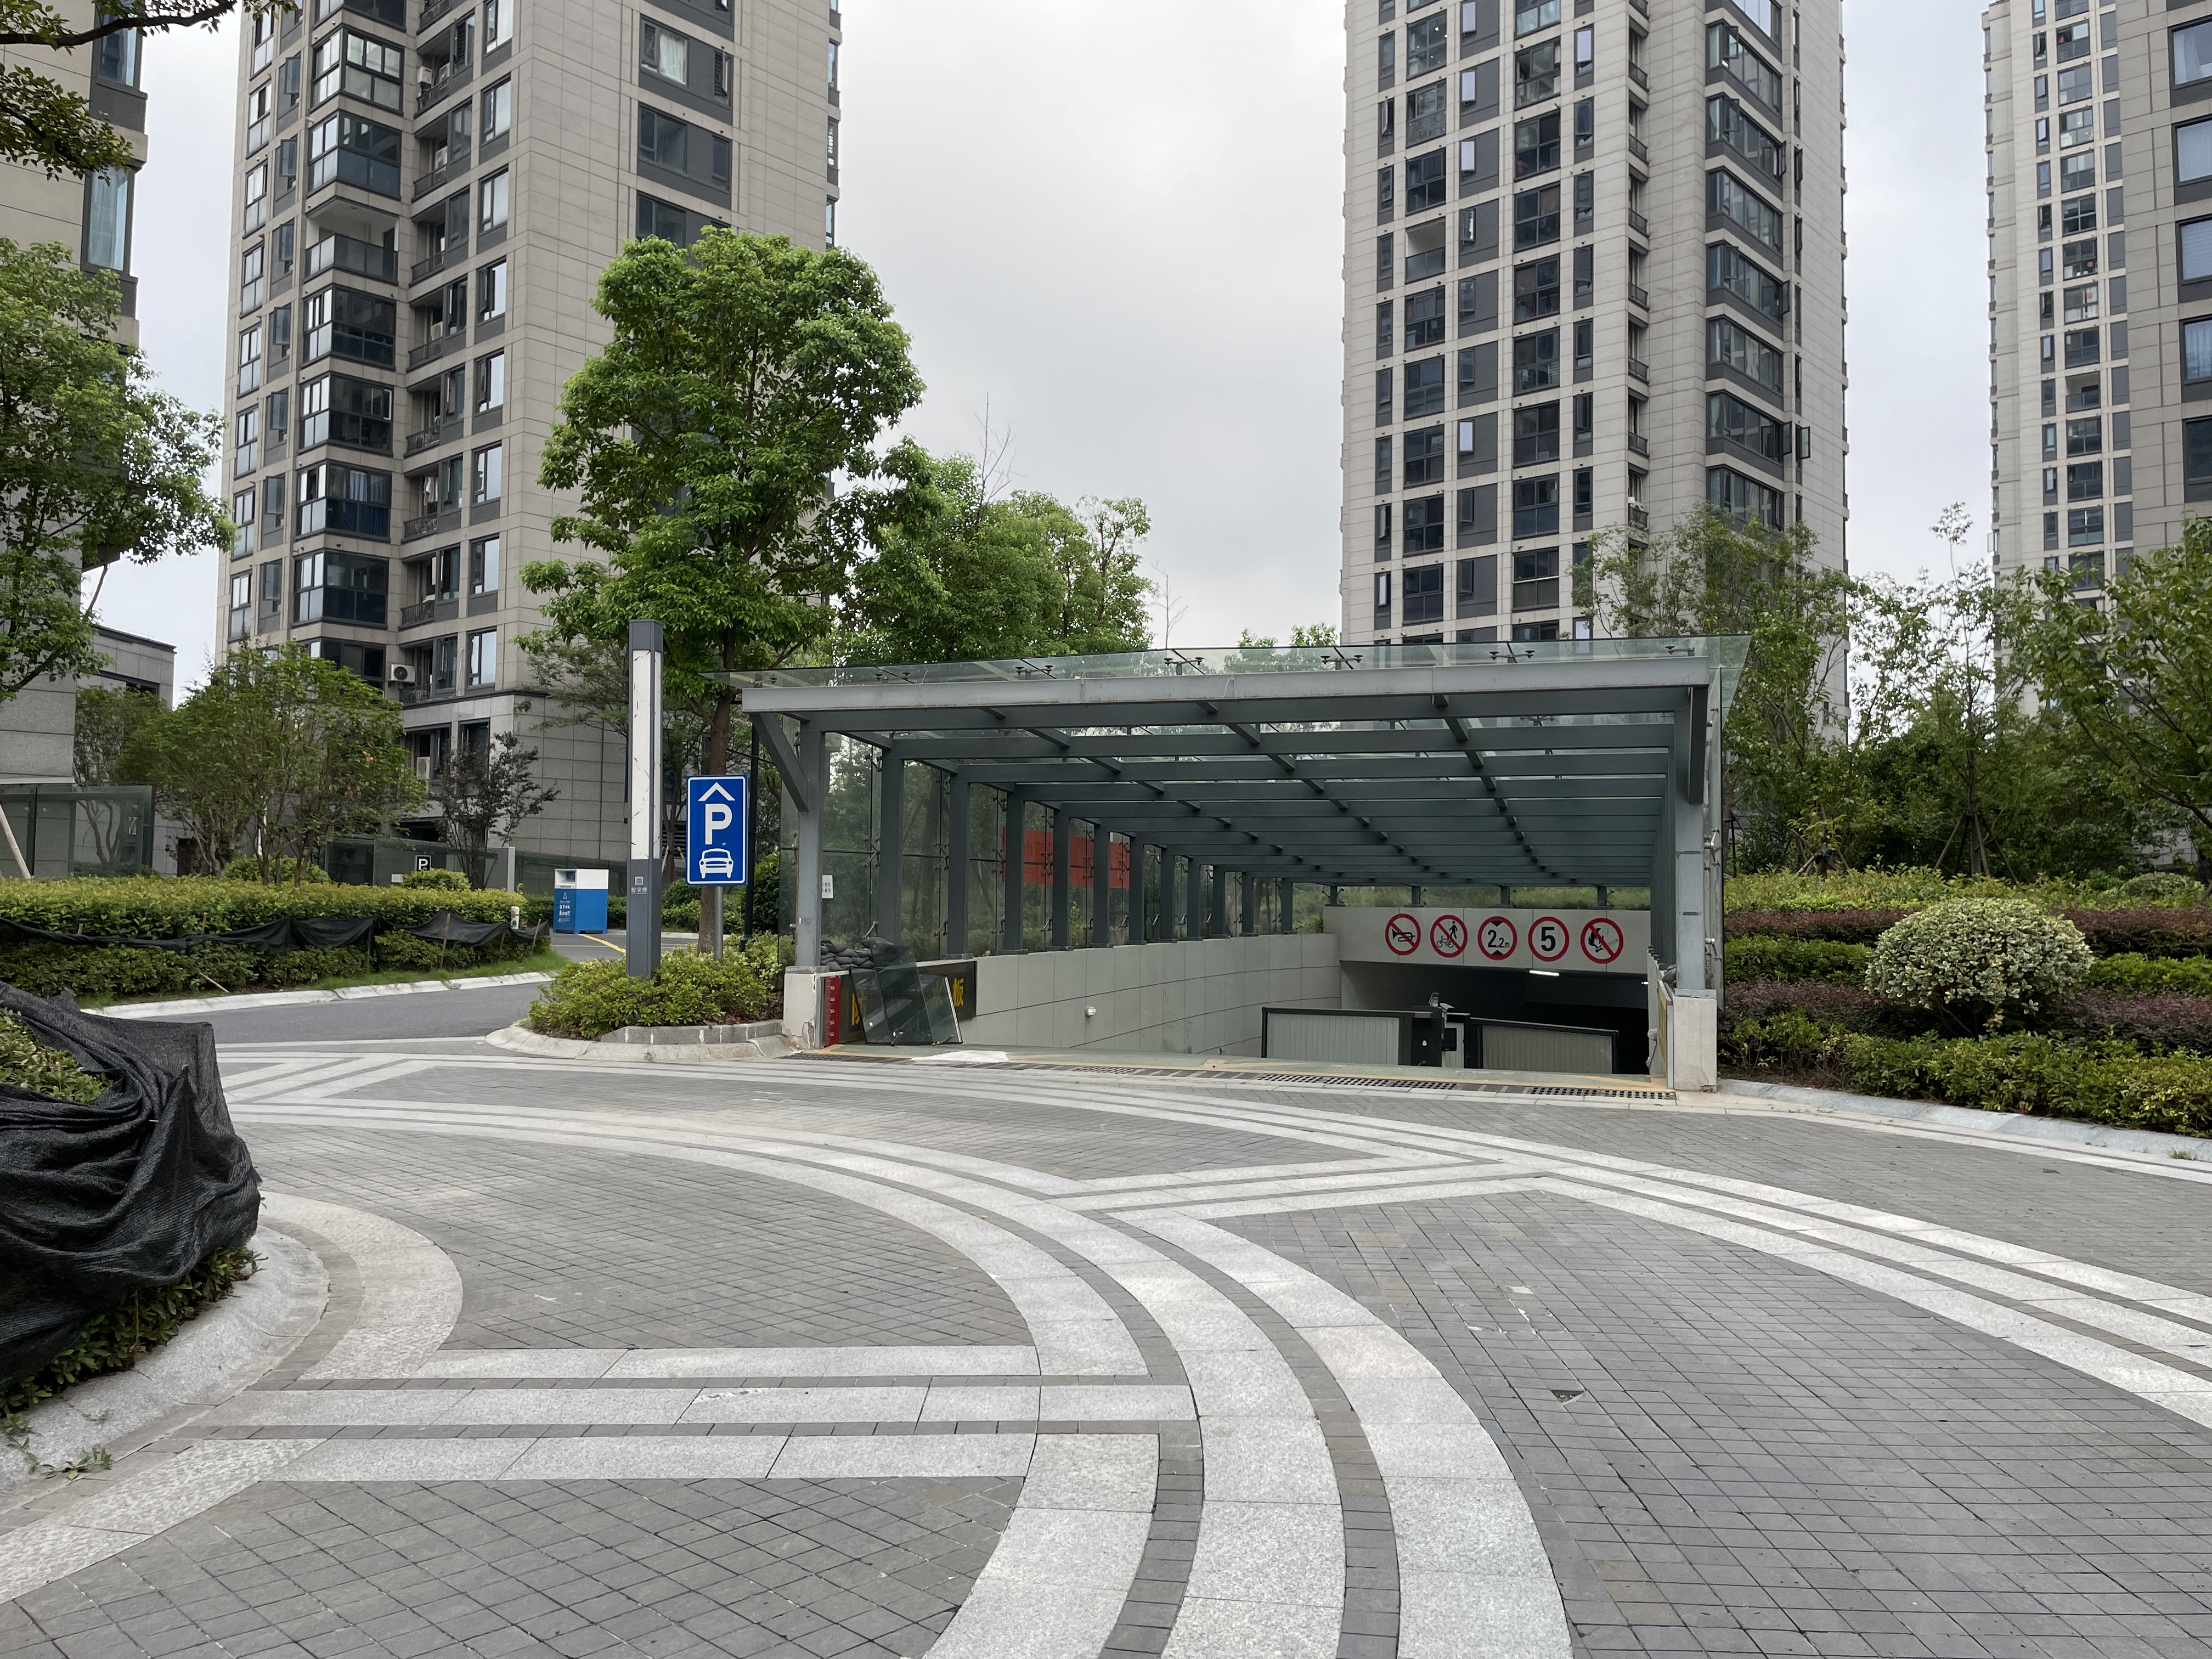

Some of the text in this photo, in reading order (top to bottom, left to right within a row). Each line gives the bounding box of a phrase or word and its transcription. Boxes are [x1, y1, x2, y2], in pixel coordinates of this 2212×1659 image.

[705, 803, 732, 845] P
[419, 859, 428, 870] P
[1487, 929, 1510, 948] 2.2m
[1541, 927, 1556, 951] 5
